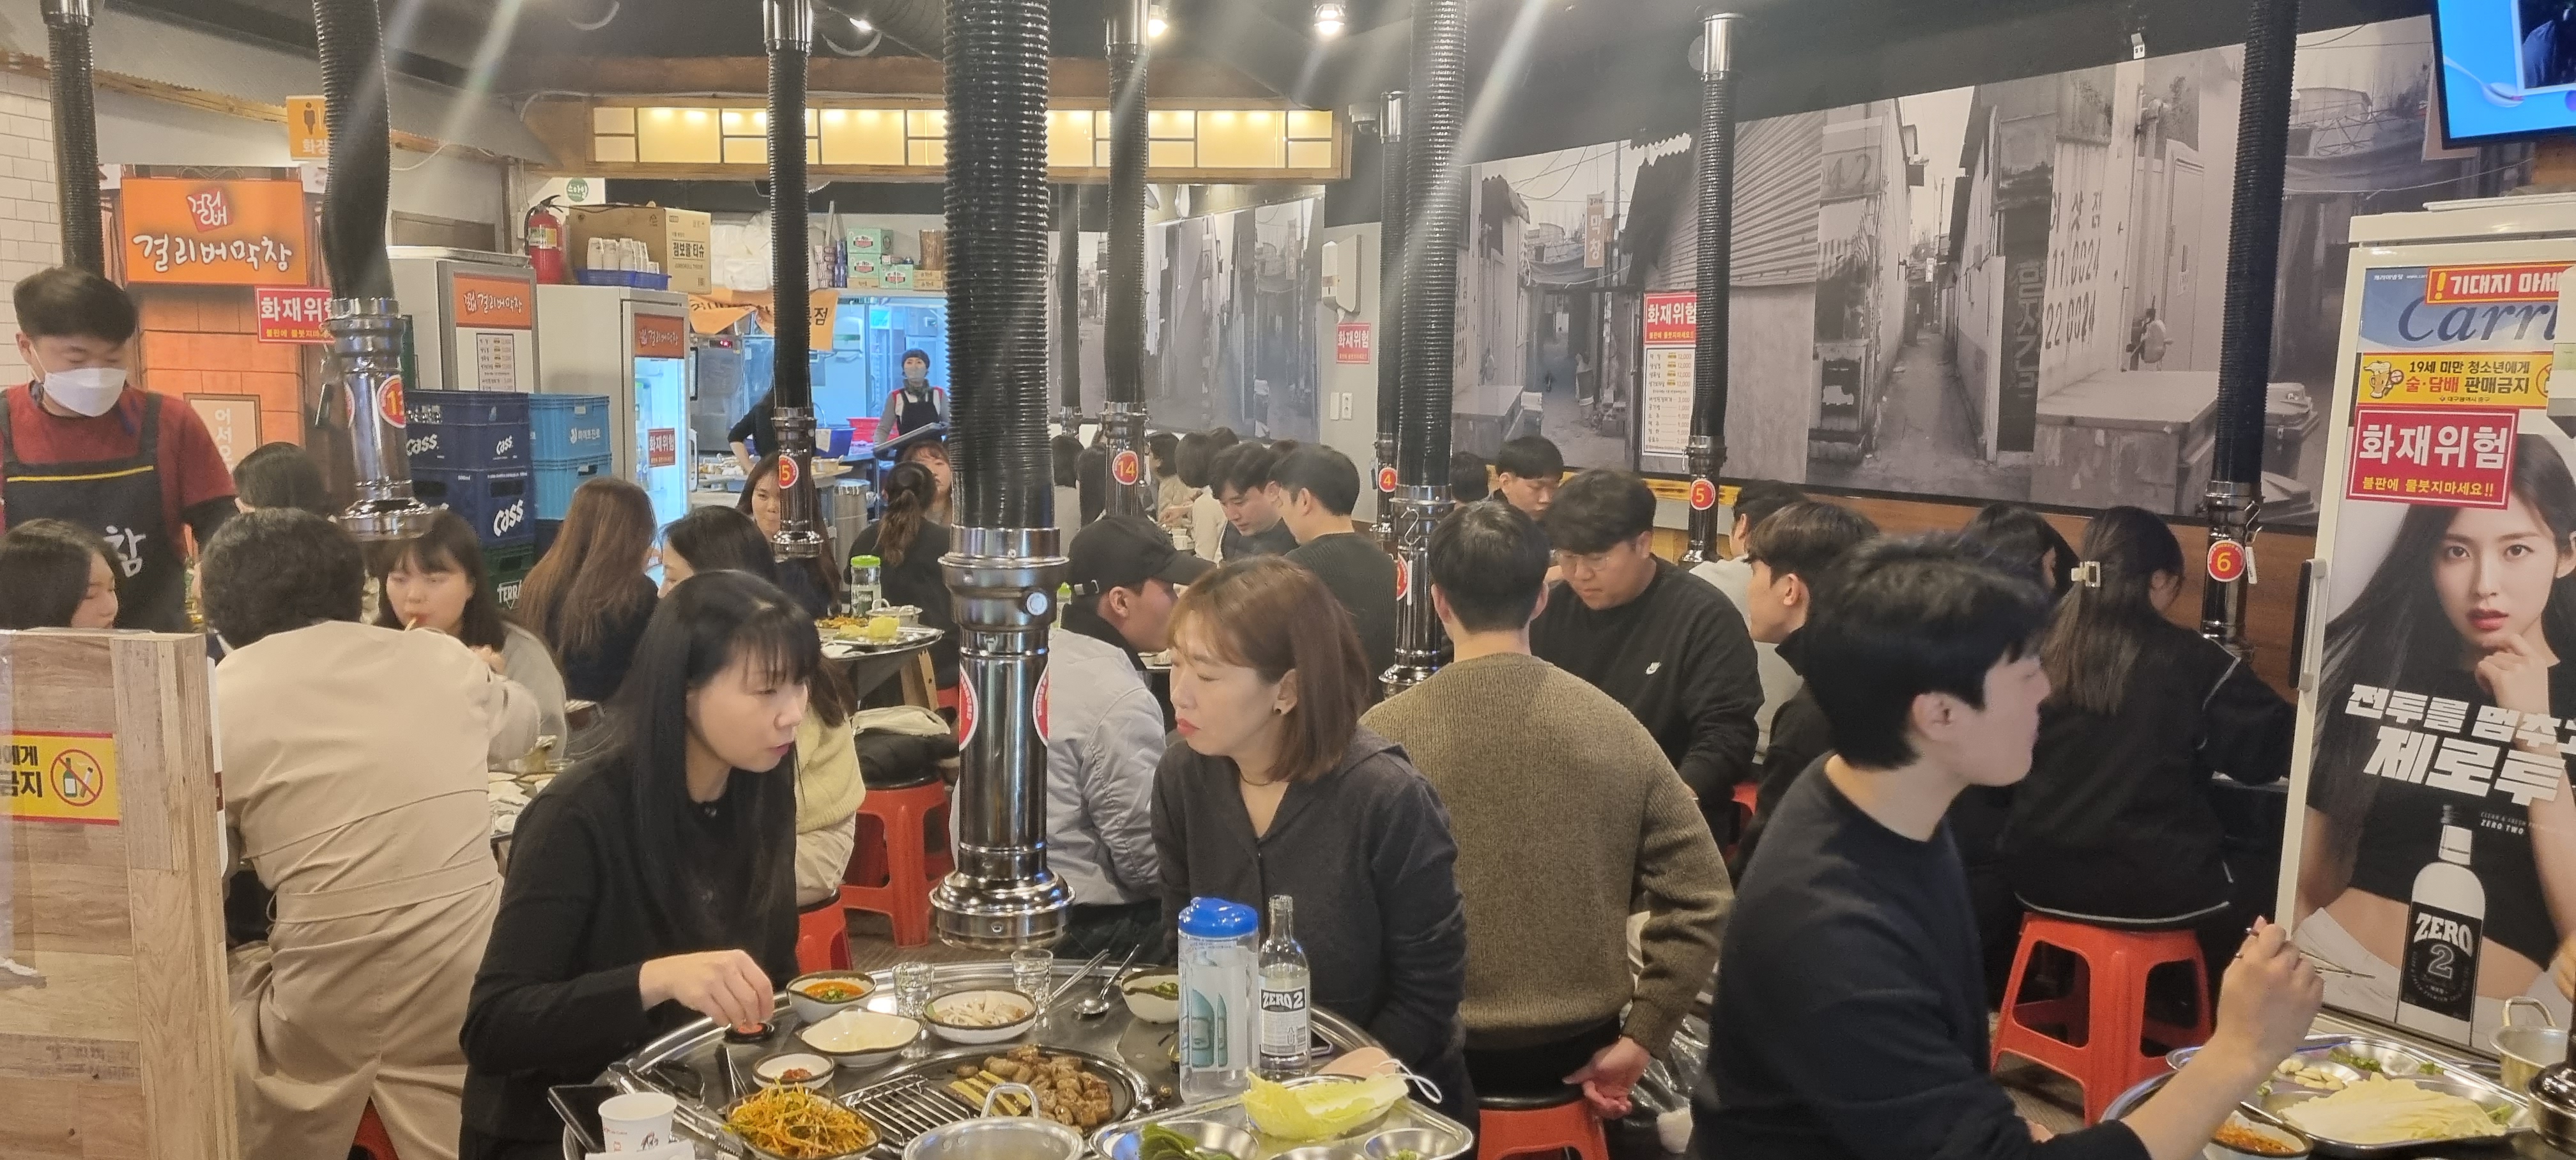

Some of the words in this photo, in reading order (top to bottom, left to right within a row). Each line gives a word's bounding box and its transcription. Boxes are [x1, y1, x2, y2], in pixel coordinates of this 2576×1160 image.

[133, 233, 292, 273] 걸리버막창
[1648, 302, 1697, 325] 화재위험
[1338, 330, 1369, 348] 화재위험
[2409, 361, 2436, 373] 19세
[2440, 362, 2464, 373] 미만
[2467, 361, 2531, 374] 청소년에게
[2464, 377, 2529, 393] 판매금지
[649, 434, 675, 452] 화재위험
[2359, 424, 2508, 469] 화재위험
[1117, 461, 1135, 477] 14
[1383, 474, 1392, 486] 4
[2362, 476, 2399, 492] 불판에
[2405, 478, 2494, 497] 물붓지마세요!!
[1696, 487, 1705, 503] 5
[493, 500, 524, 537] Cass
[2217, 552, 2232, 572] 6
[2345, 683, 2469, 734] 전투를
[2363, 725, 2566, 806] 제로투
[2480, 819, 2503, 830] ZERO
[2506, 824, 2524, 834] TWO
[2413, 912, 2473, 958] ZERO
[2428, 943, 2454, 980] 2
[1262, 991, 1292, 1009] ZERO
[1292, 991, 1304, 1009] 2
